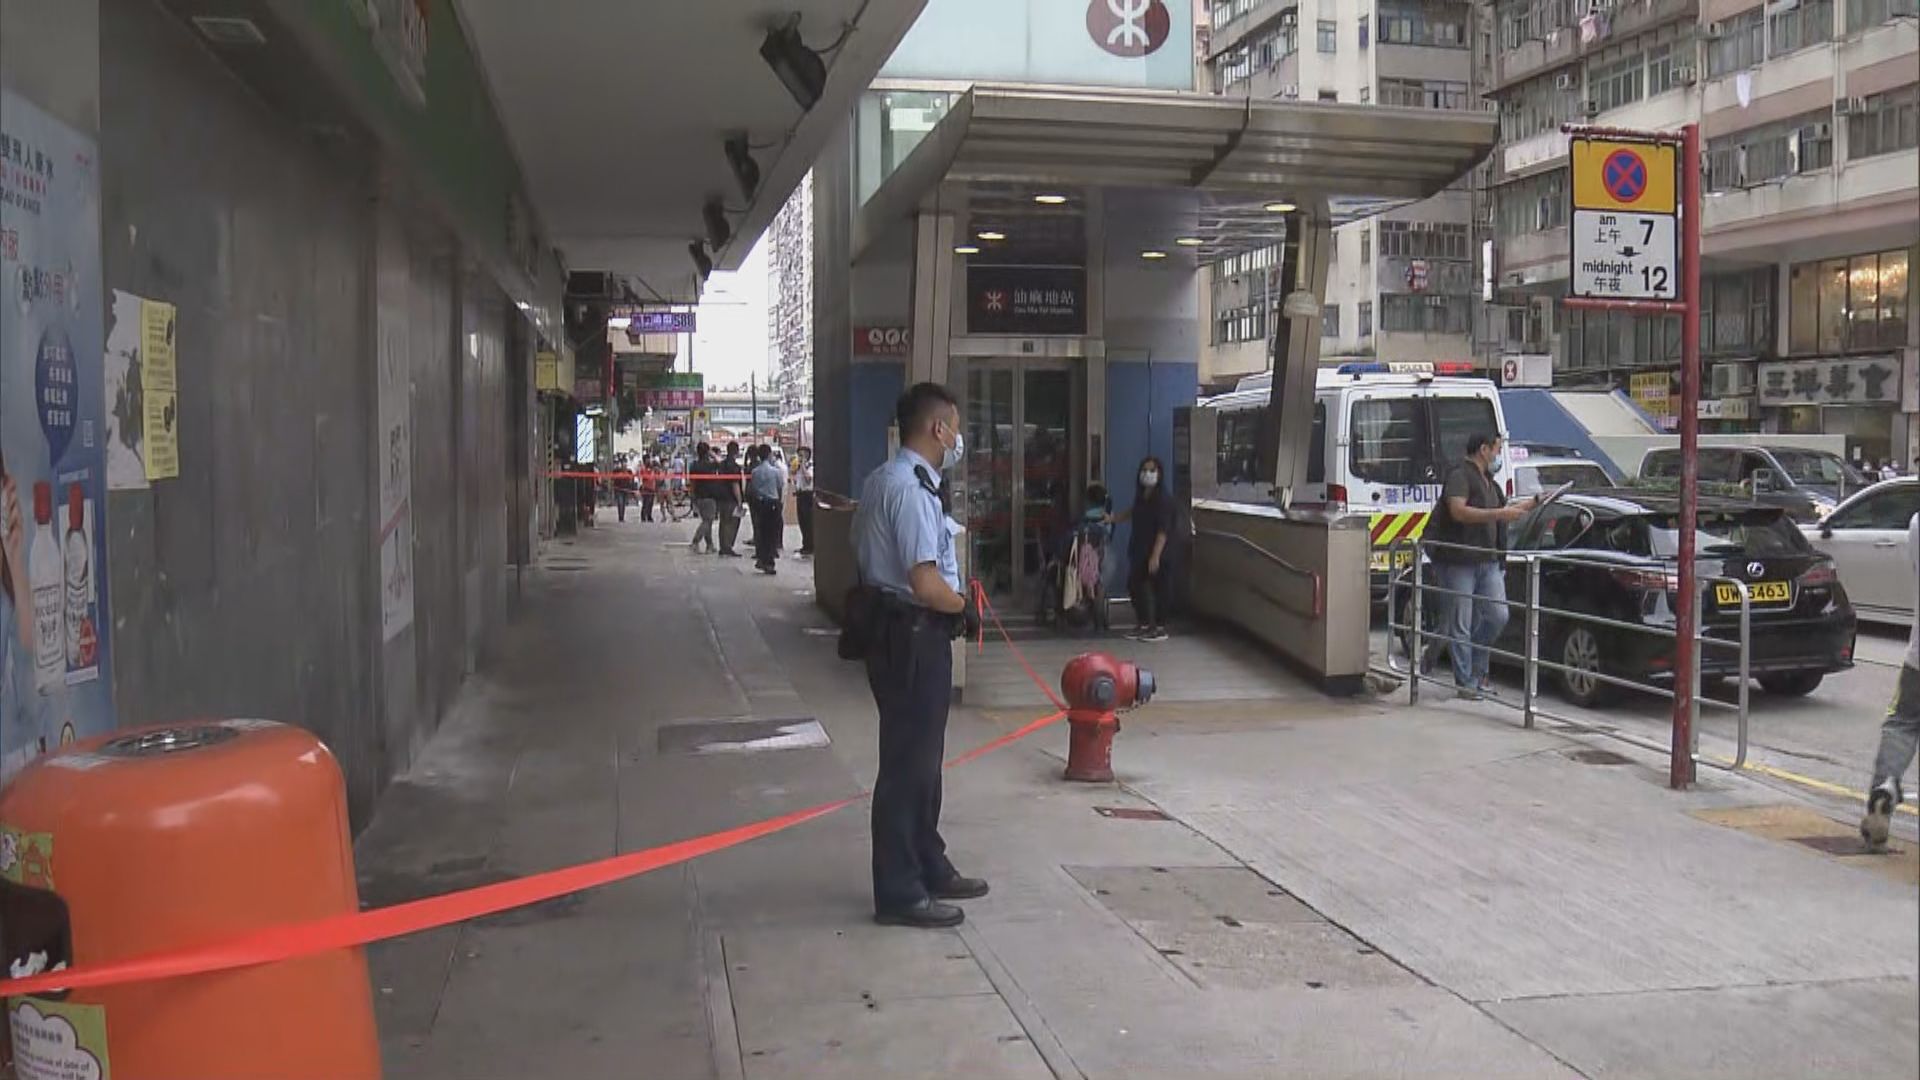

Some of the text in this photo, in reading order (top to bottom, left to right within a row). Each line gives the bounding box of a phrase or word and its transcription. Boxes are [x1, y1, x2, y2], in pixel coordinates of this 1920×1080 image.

[1600, 215, 1616, 225] am
[1594, 228, 1621, 244] 上午
[1639, 220, 1654, 245] 7
[1582, 260, 1633, 276] midnight
[1594, 276, 1621, 292] 午夜
[1641, 266, 1667, 291] 12
[1403, 485, 1439, 503] POLI
[1747, 584, 1786, 599] 5463
